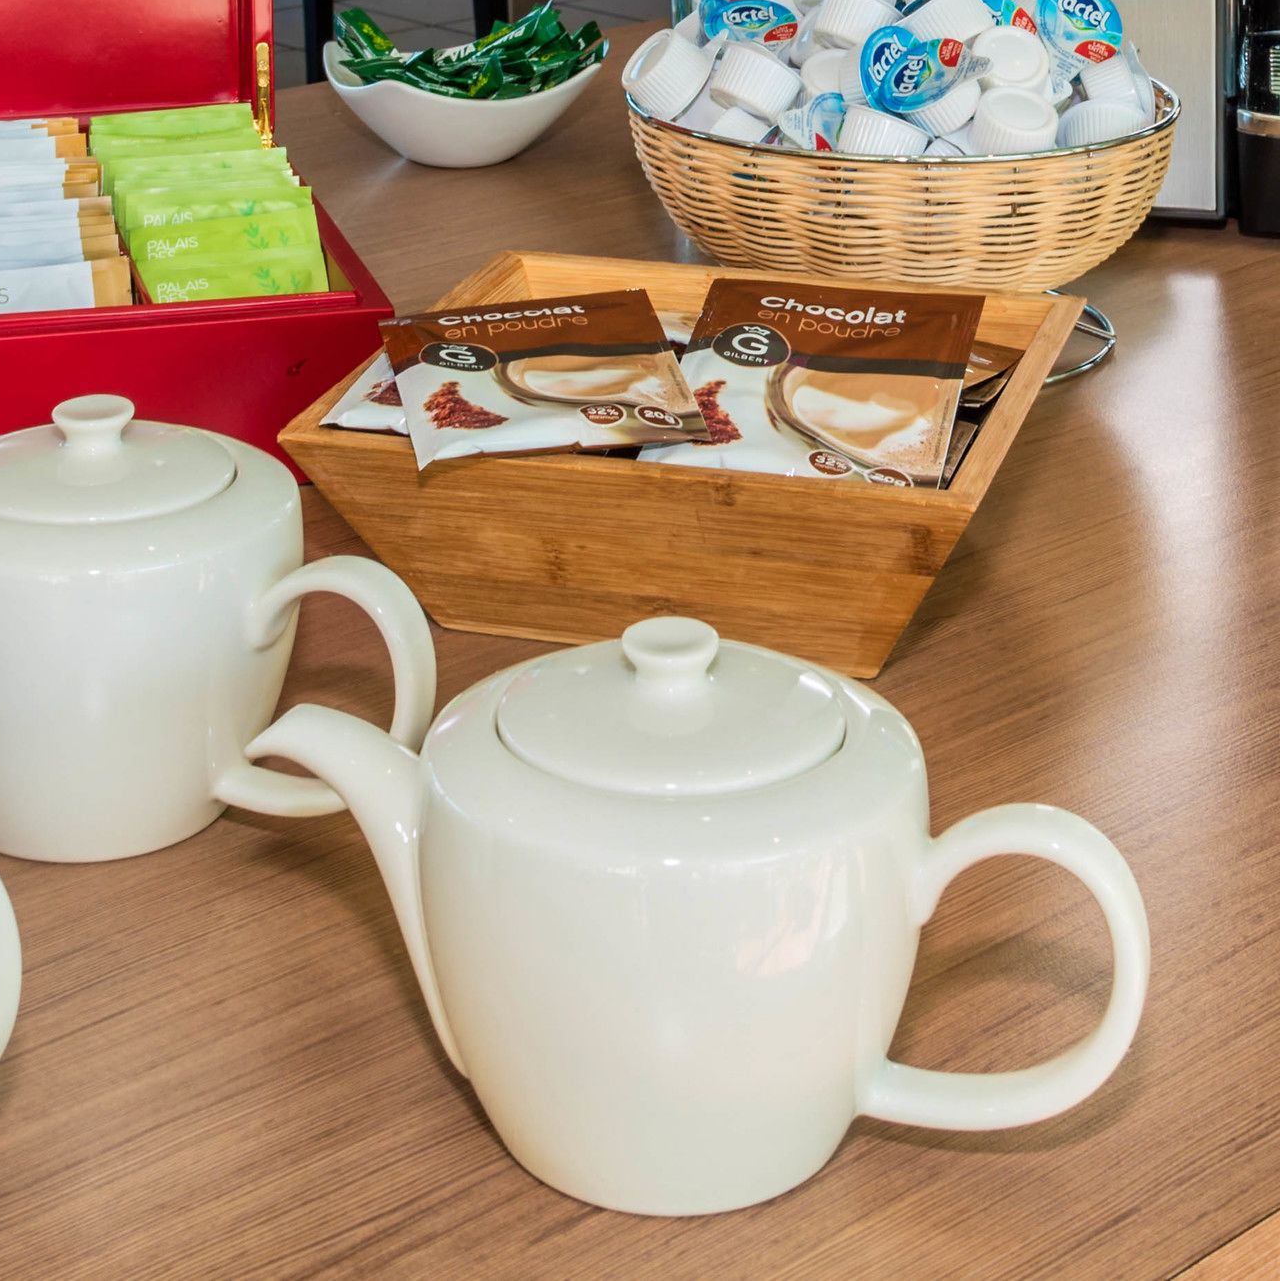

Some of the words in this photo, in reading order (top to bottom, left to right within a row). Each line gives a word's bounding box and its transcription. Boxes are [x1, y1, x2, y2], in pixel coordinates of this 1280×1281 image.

[147, 236, 199, 254] PALAIS
[157, 278, 209, 295] PALAIS
[760, 296, 907, 325] Chocolat
[444, 326, 479, 340] en
[487, 315, 589, 337] poudre
[757, 310, 791, 324] en
[798, 317, 902, 340] poudre
[731, 333, 770, 356] G
[439, 348, 477, 365] G
[723, 350, 770, 366] GILBERT
[439, 361, 485, 370] GILBERT
[586, 406, 620, 417] 32%
